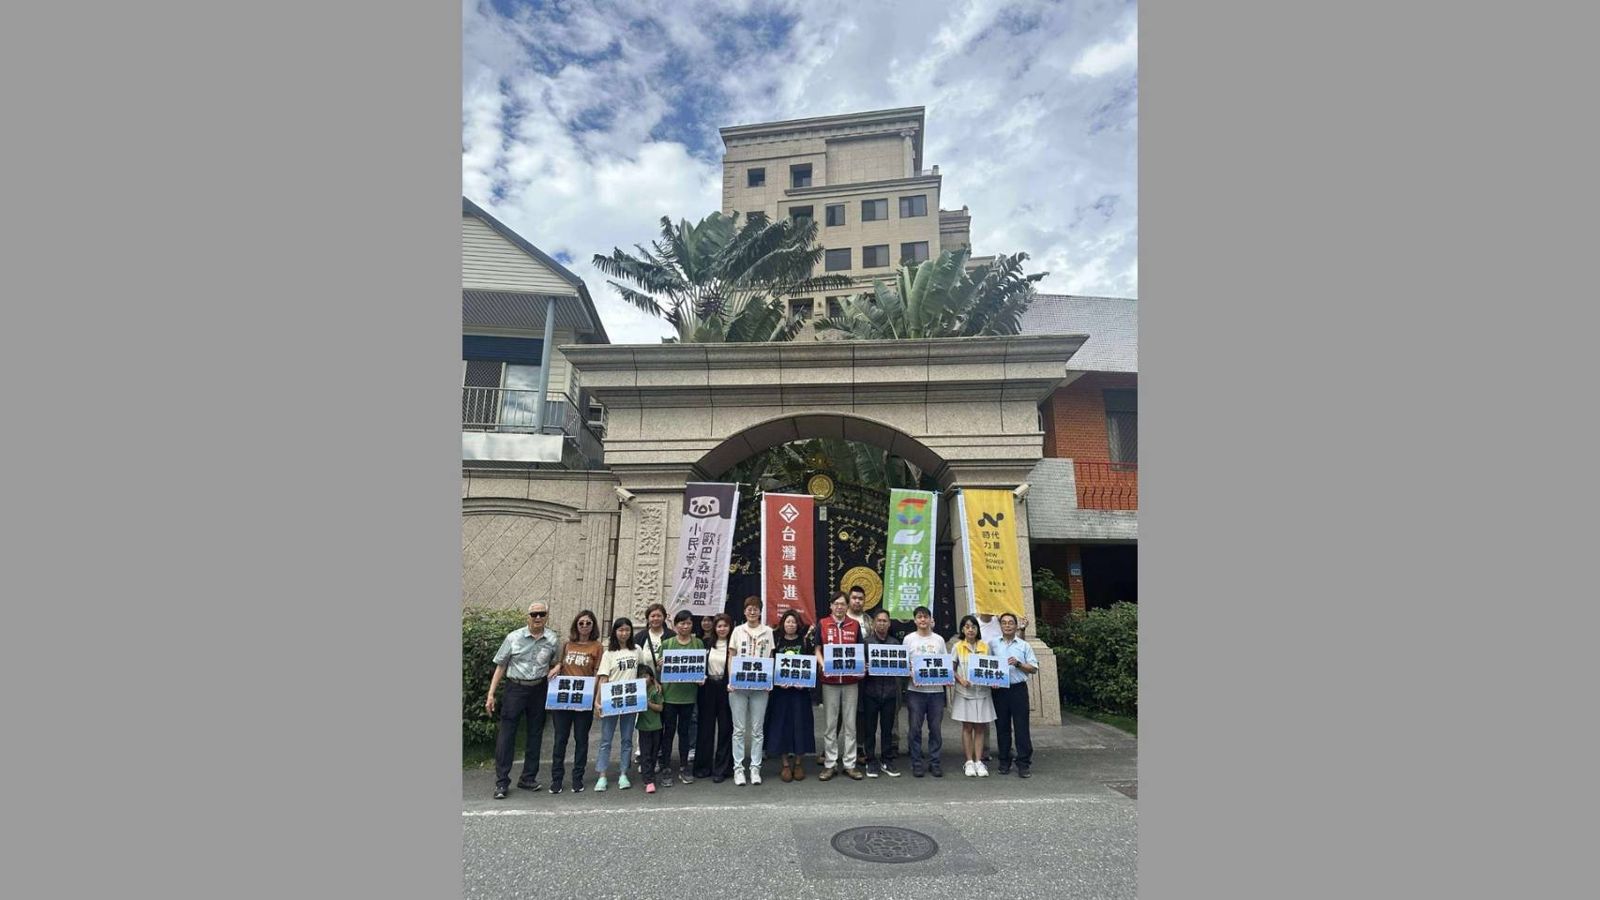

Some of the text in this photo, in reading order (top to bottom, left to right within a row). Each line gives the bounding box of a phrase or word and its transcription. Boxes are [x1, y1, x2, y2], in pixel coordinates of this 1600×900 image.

[982, 531, 999, 539] 時代
[682, 522, 701, 579] 小民參政
[692, 532, 715, 605] 歐巴桑聯盟
[782, 526, 798, 600] 台灣基進
[898, 550, 922, 611] 綠黨
[780, 658, 811, 668] 大罷免
[923, 658, 943, 667] 下架
[780, 669, 811, 679] 救台灣
[919, 668, 948, 678] 花蓮王
[557, 691, 583, 704] 自由
[611, 695, 637, 708] 花蓮
